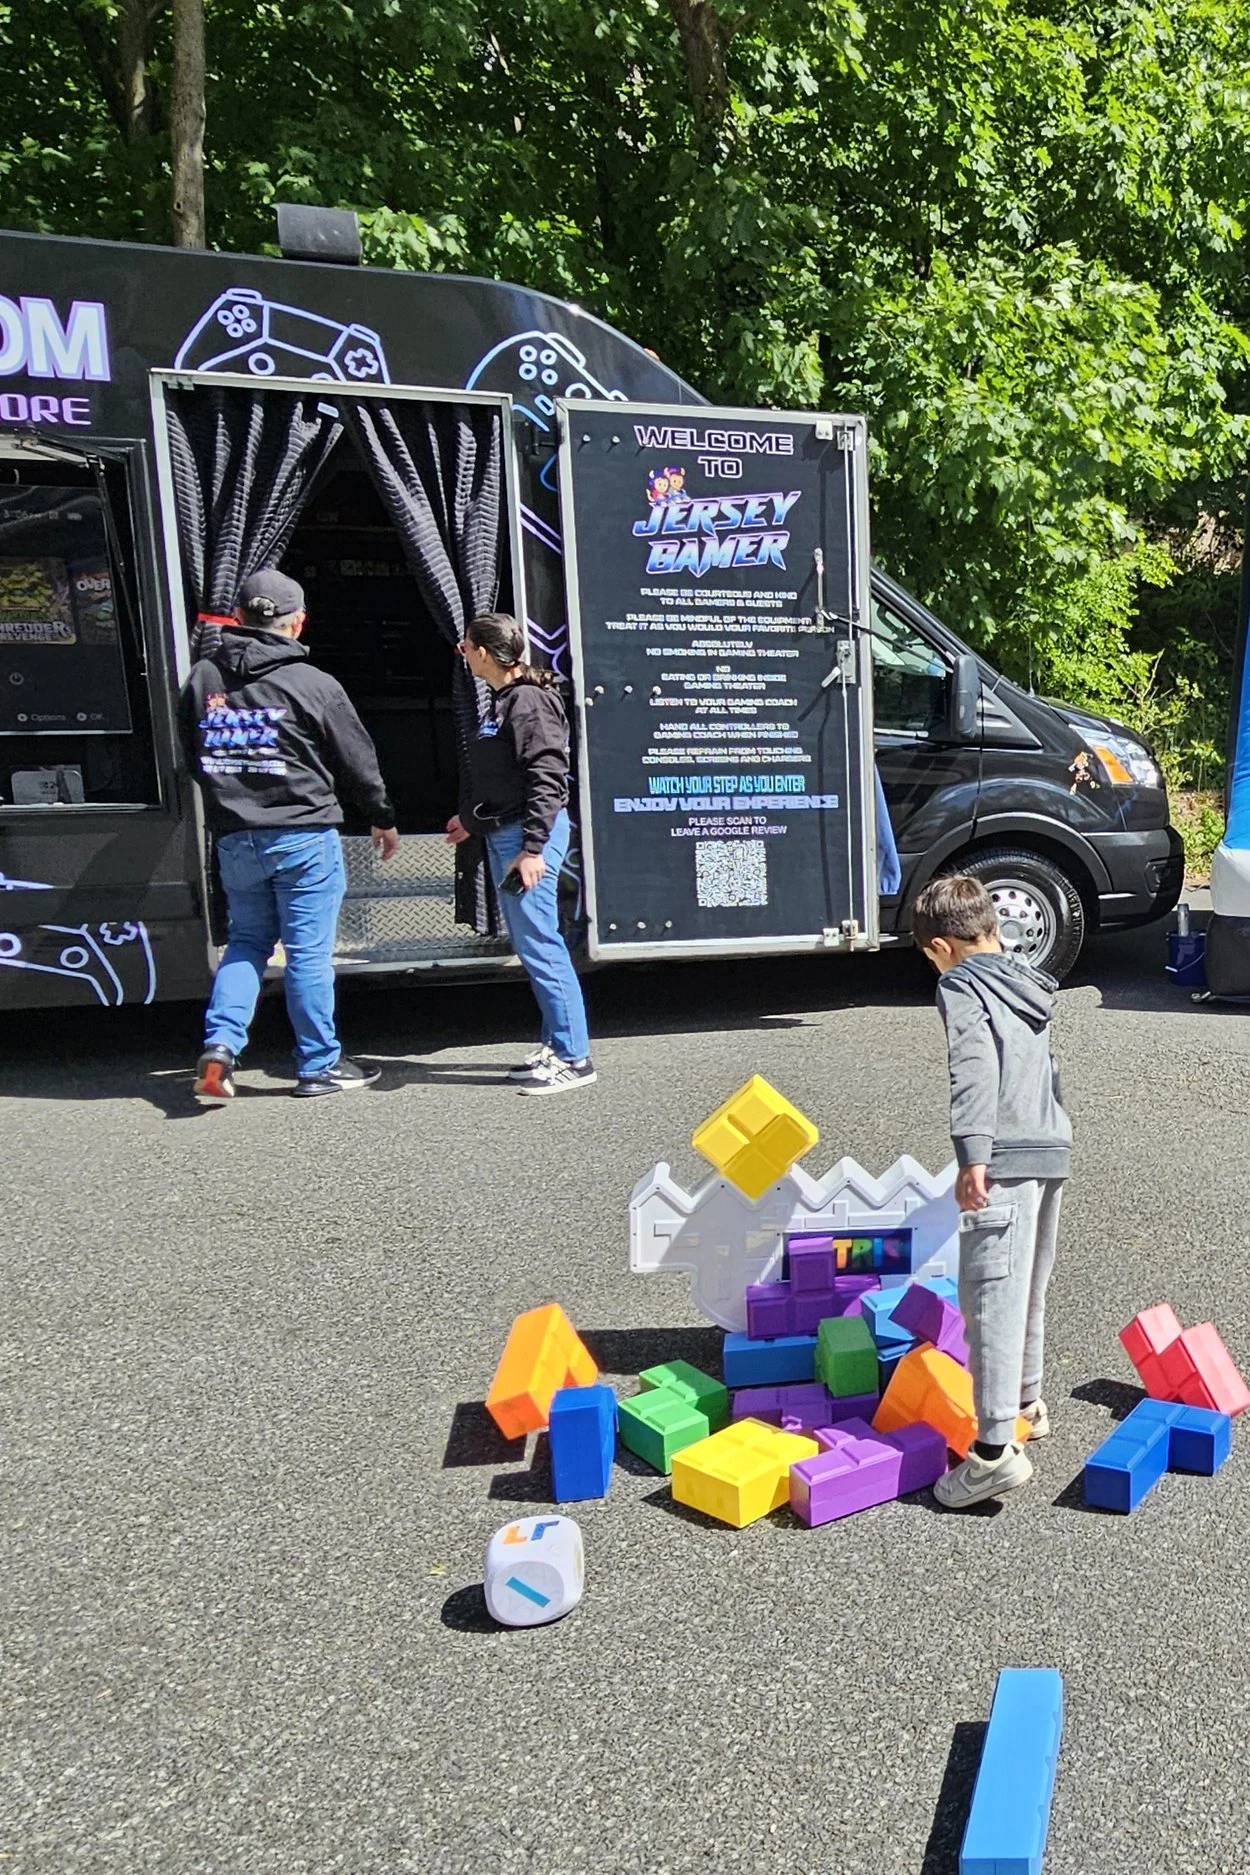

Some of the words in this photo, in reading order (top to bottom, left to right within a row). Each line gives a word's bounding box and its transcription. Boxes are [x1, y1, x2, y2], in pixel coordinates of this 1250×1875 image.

[633, 425, 794, 455] WELCOME
[698, 456, 742, 479] TO
[632, 491, 802, 537] JERSEY
[640, 588, 678, 597] PLEASE
[680, 589, 693, 597] BE
[694, 589, 752, 599] COURTEOUS
[754, 591, 774, 599] AND
[775, 591, 797, 600] KIND
[675, 598, 694, 606] ALL
[694, 598, 735, 607] GAMERS
[746, 599, 782, 608] GUESTS
[626, 614, 664, 622] PLEASE
[680, 615, 722, 623] MINDFUL
[723, 616, 736, 624] OF
[738, 616, 756, 624] THE
[606, 622, 637, 630] TREAT
[650, 623, 664, 631] AS
[665, 623, 686, 631] YOU
[688, 623, 723, 632] WOULD
[724, 624, 751, 632] YOUR
[752, 625, 796, 633] FAVORITE
[692, 640, 753, 648] ABSOLUTELY
[646, 648, 661, 656] NO
[662, 648, 706, 656] SMOKING
[719, 649, 755, 657] GAMING
[757, 649, 799, 658] THEATER
[661, 673, 696, 681] EATING
[713, 674, 756, 682] DRINKING
[757, 674, 786, 682] INSIDE
[723, 682, 766, 690] THEATER
[649, 698, 683, 706] LISTEN
[684, 698, 697, 706] TO
[698, 698, 726, 706] YOUR
[727, 698, 764, 706] GAMING
[765, 698, 798, 706] COACH
[653, 731, 692, 739] GAMING
[693, 731, 726, 739] COACH
[728, 731, 756, 739] WHEN
[729, 747, 756, 755] FROM
[696, 755, 739, 763] SCREENS
[740, 755, 760, 763] AND
[762, 755, 812, 763] CHARGERS
[649, 777, 684, 794] WATCH
[685, 776, 711, 793] YOUR
[714, 776, 737, 793] STEP
[740, 776, 753, 792] AS
[754, 776, 774, 792] YOU
[775, 775, 805, 792] ENTER
[614, 797, 678, 812] ENJOY
[680, 797, 731, 811] YOUR
[733, 795, 838, 810] EXPERIENCE
[689, 817, 724, 826] PLEASE
[727, 817, 752, 825] SCAN
[754, 816, 766, 825] TO
[671, 827, 701, 836] LEAVE
[702, 827, 709, 836] A
[710, 826, 750, 835] GOOGLE
[752, 826, 787, 835] REVIEW
